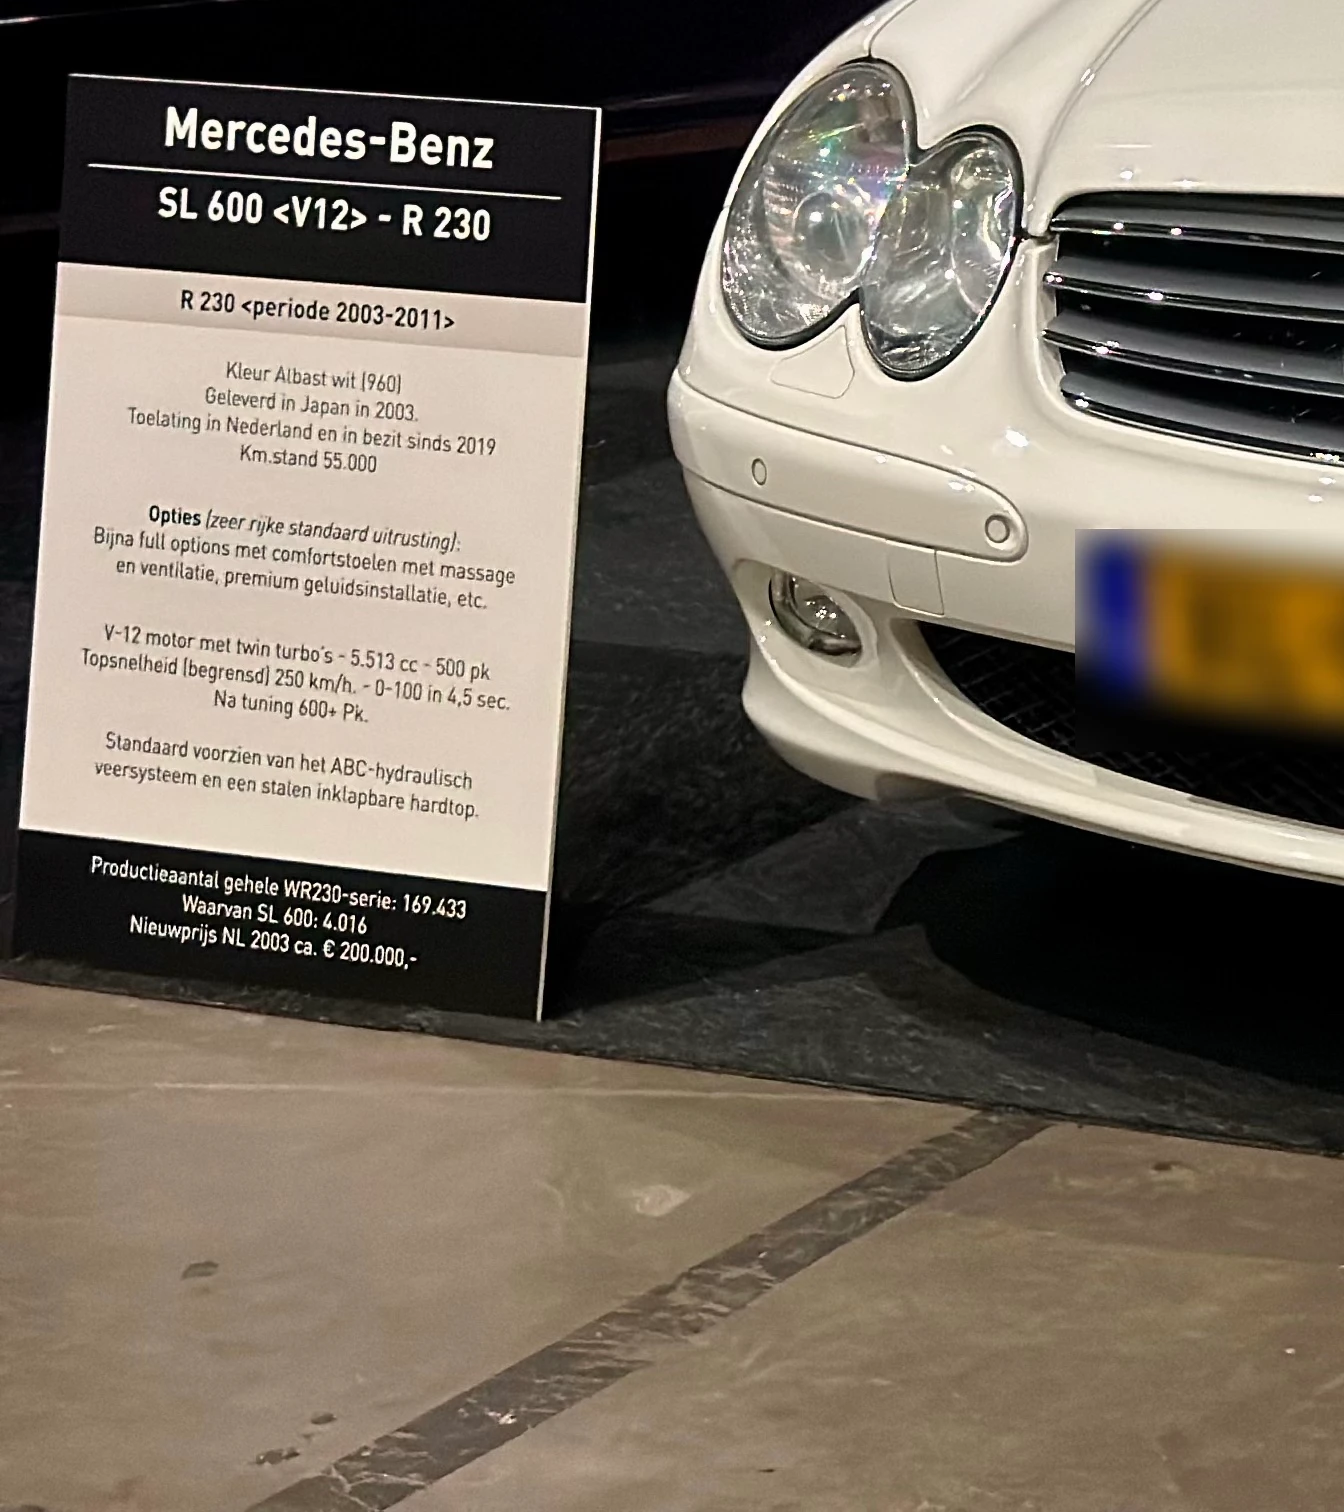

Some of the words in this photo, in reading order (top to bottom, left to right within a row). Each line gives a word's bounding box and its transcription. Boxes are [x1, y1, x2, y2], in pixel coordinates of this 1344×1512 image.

[164, 105, 493, 168] Mercedes-Benz
[157, 186, 197, 219] SL
[207, 189, 262, 223] 600
[273, 195, 366, 230] <V12>
[402, 203, 423, 236] R
[433, 206, 490, 240] 230
[180, 289, 193, 310] R
[199, 291, 234, 313] 230
[240, 297, 330, 320] <periode
[335, 301, 454, 329] 2003-2011>
[226, 360, 271, 381] Kleur
[273, 365, 327, 387] Albast
[330, 371, 355, 389] wit
[204, 386, 275, 410] Geleverd
[281, 393, 295, 411] in
[300, 394, 349, 419] Japan
[355, 399, 369, 417] in
[373, 400, 417, 421] 2003.
[127, 406, 201, 434] Toelating
[205, 412, 220, 431] in
[226, 415, 312, 440] Nederland
[317, 428, 337, 442] en
[342, 425, 357, 443] in
[362, 427, 401, 448] bezit
[406, 431, 451, 452] sinds
[456, 435, 496, 455] 2019
[239, 443, 318, 467] Km.stand
[323, 450, 377, 473] 55.000
[148, 504, 201, 527] Opties
[247, 516, 284, 537] rijke
[288, 520, 369, 542] standaard
[93, 525, 134, 550] Bijna
[139, 530, 165, 550] full
[170, 535, 229, 557] options
[235, 544, 267, 560] met
[271, 546, 396, 572] comfortstoelen
[402, 560, 434, 576] met
[439, 564, 515, 588] massage
[116, 560, 135, 574] en
[140, 560, 219, 585] ventilatie,
[223, 570, 298, 590] premium
[303, 575, 451, 608] geluidsinstallatie,
[457, 591, 486, 608] etc.
[81, 647, 177, 675] Topsnelheid
[274, 667, 304, 688] 250
[309, 671, 355, 694] km/h.
[375, 678, 422, 700] 0-100
[427, 684, 442, 703] in
[447, 686, 472, 707] 4,5
[476, 694, 509, 710] sec.
[104, 623, 141, 644] V-12
[145, 631, 195, 648] motor
[199, 637, 230, 653] met
[236, 637, 270, 657] twin
[350, 648, 394, 670] 5.513
[399, 658, 417, 672] cc
[436, 657, 465, 677] 500
[469, 661, 490, 683] pk
[214, 689, 236, 708] Na
[241, 692, 293, 719] tuning
[298, 698, 336, 718] 600+
[342, 702, 367, 722] Pk.
[105, 730, 188, 757] Standaard
[192, 745, 261, 766] voorzien
[266, 753, 294, 769] van
[299, 753, 325, 774] het
[330, 756, 472, 789] ABC-hydraulisch
[95, 762, 196, 785] veersysteem
[202, 774, 221, 788] en
[227, 777, 256, 792] een
[261, 779, 311, 799] stalen
[316, 782, 404, 810] inklapbare
[410, 792, 478, 821] hardtop.
[91, 855, 219, 889] Productieaantal
[223, 874, 278, 896] gehele
[283, 878, 396, 910] WR230-serie:
[403, 893, 466, 919] 169.433
[182, 893, 252, 919] Waarvan
[256, 903, 278, 923] SL
[283, 906, 317, 928] 600:
[322, 911, 366, 934] 4.016
[129, 914, 217, 946] Nieuwprijs
[222, 926, 245, 947] NL
[250, 929, 289, 952] 2003
[293, 940, 316, 955] ca.
[322, 938, 335, 958] €
[339, 940, 416, 969] 200.000,-
